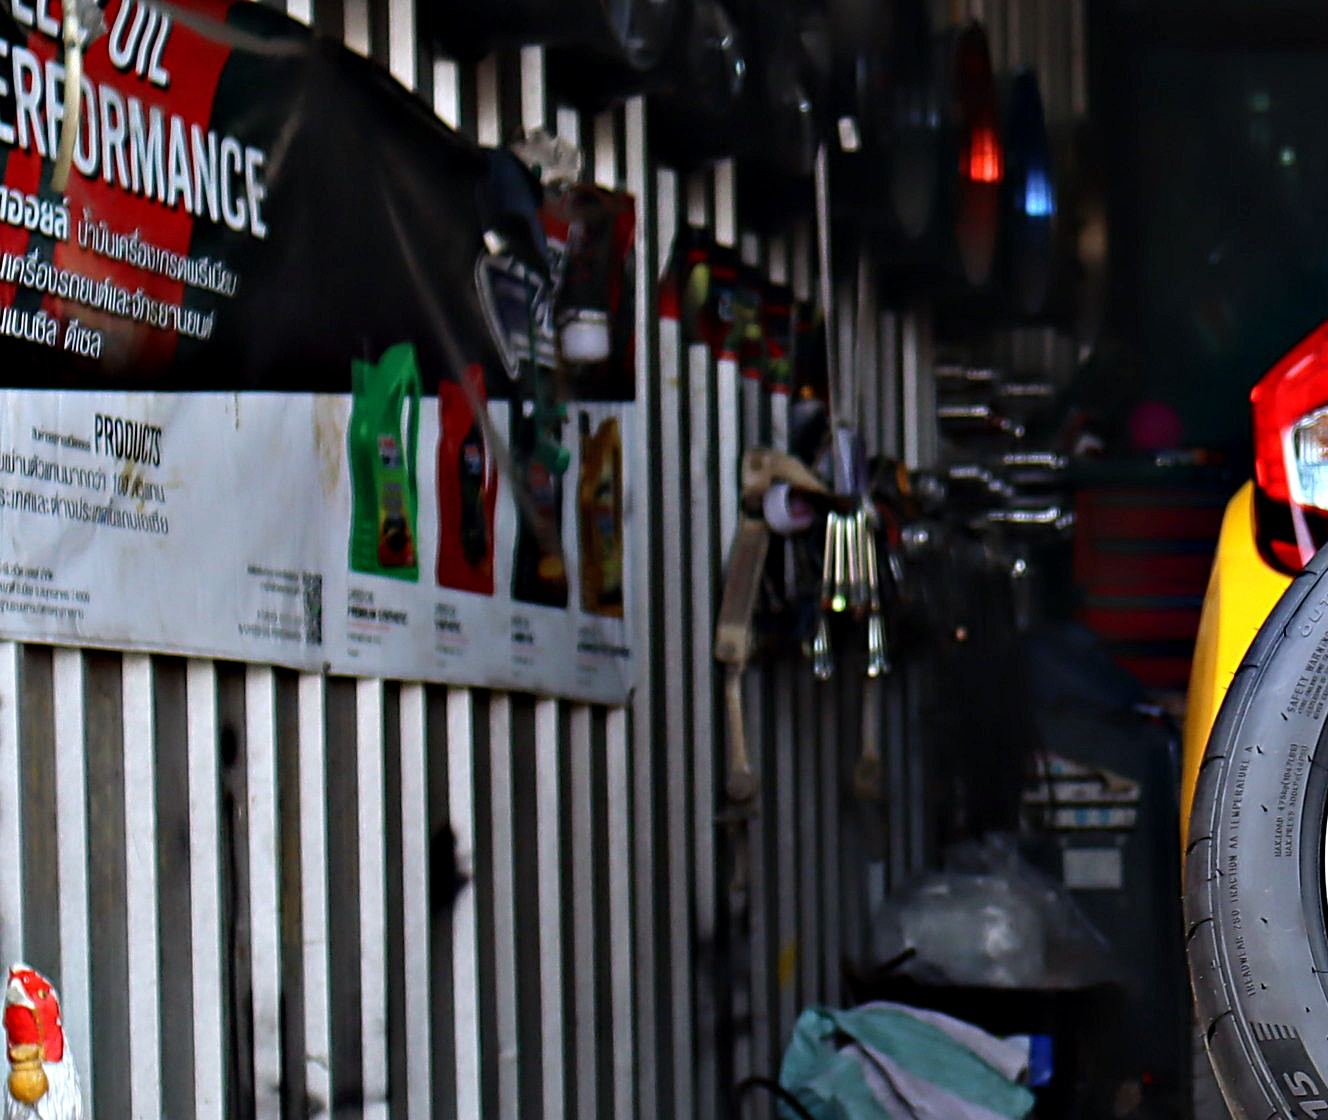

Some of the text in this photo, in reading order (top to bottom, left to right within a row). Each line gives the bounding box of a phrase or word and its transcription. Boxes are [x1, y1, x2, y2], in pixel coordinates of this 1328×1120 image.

[109, 0, 171, 87] OIL
[94, 412, 163, 468] PRODUCTS
[1285, 675, 1310, 713] SAFETY
